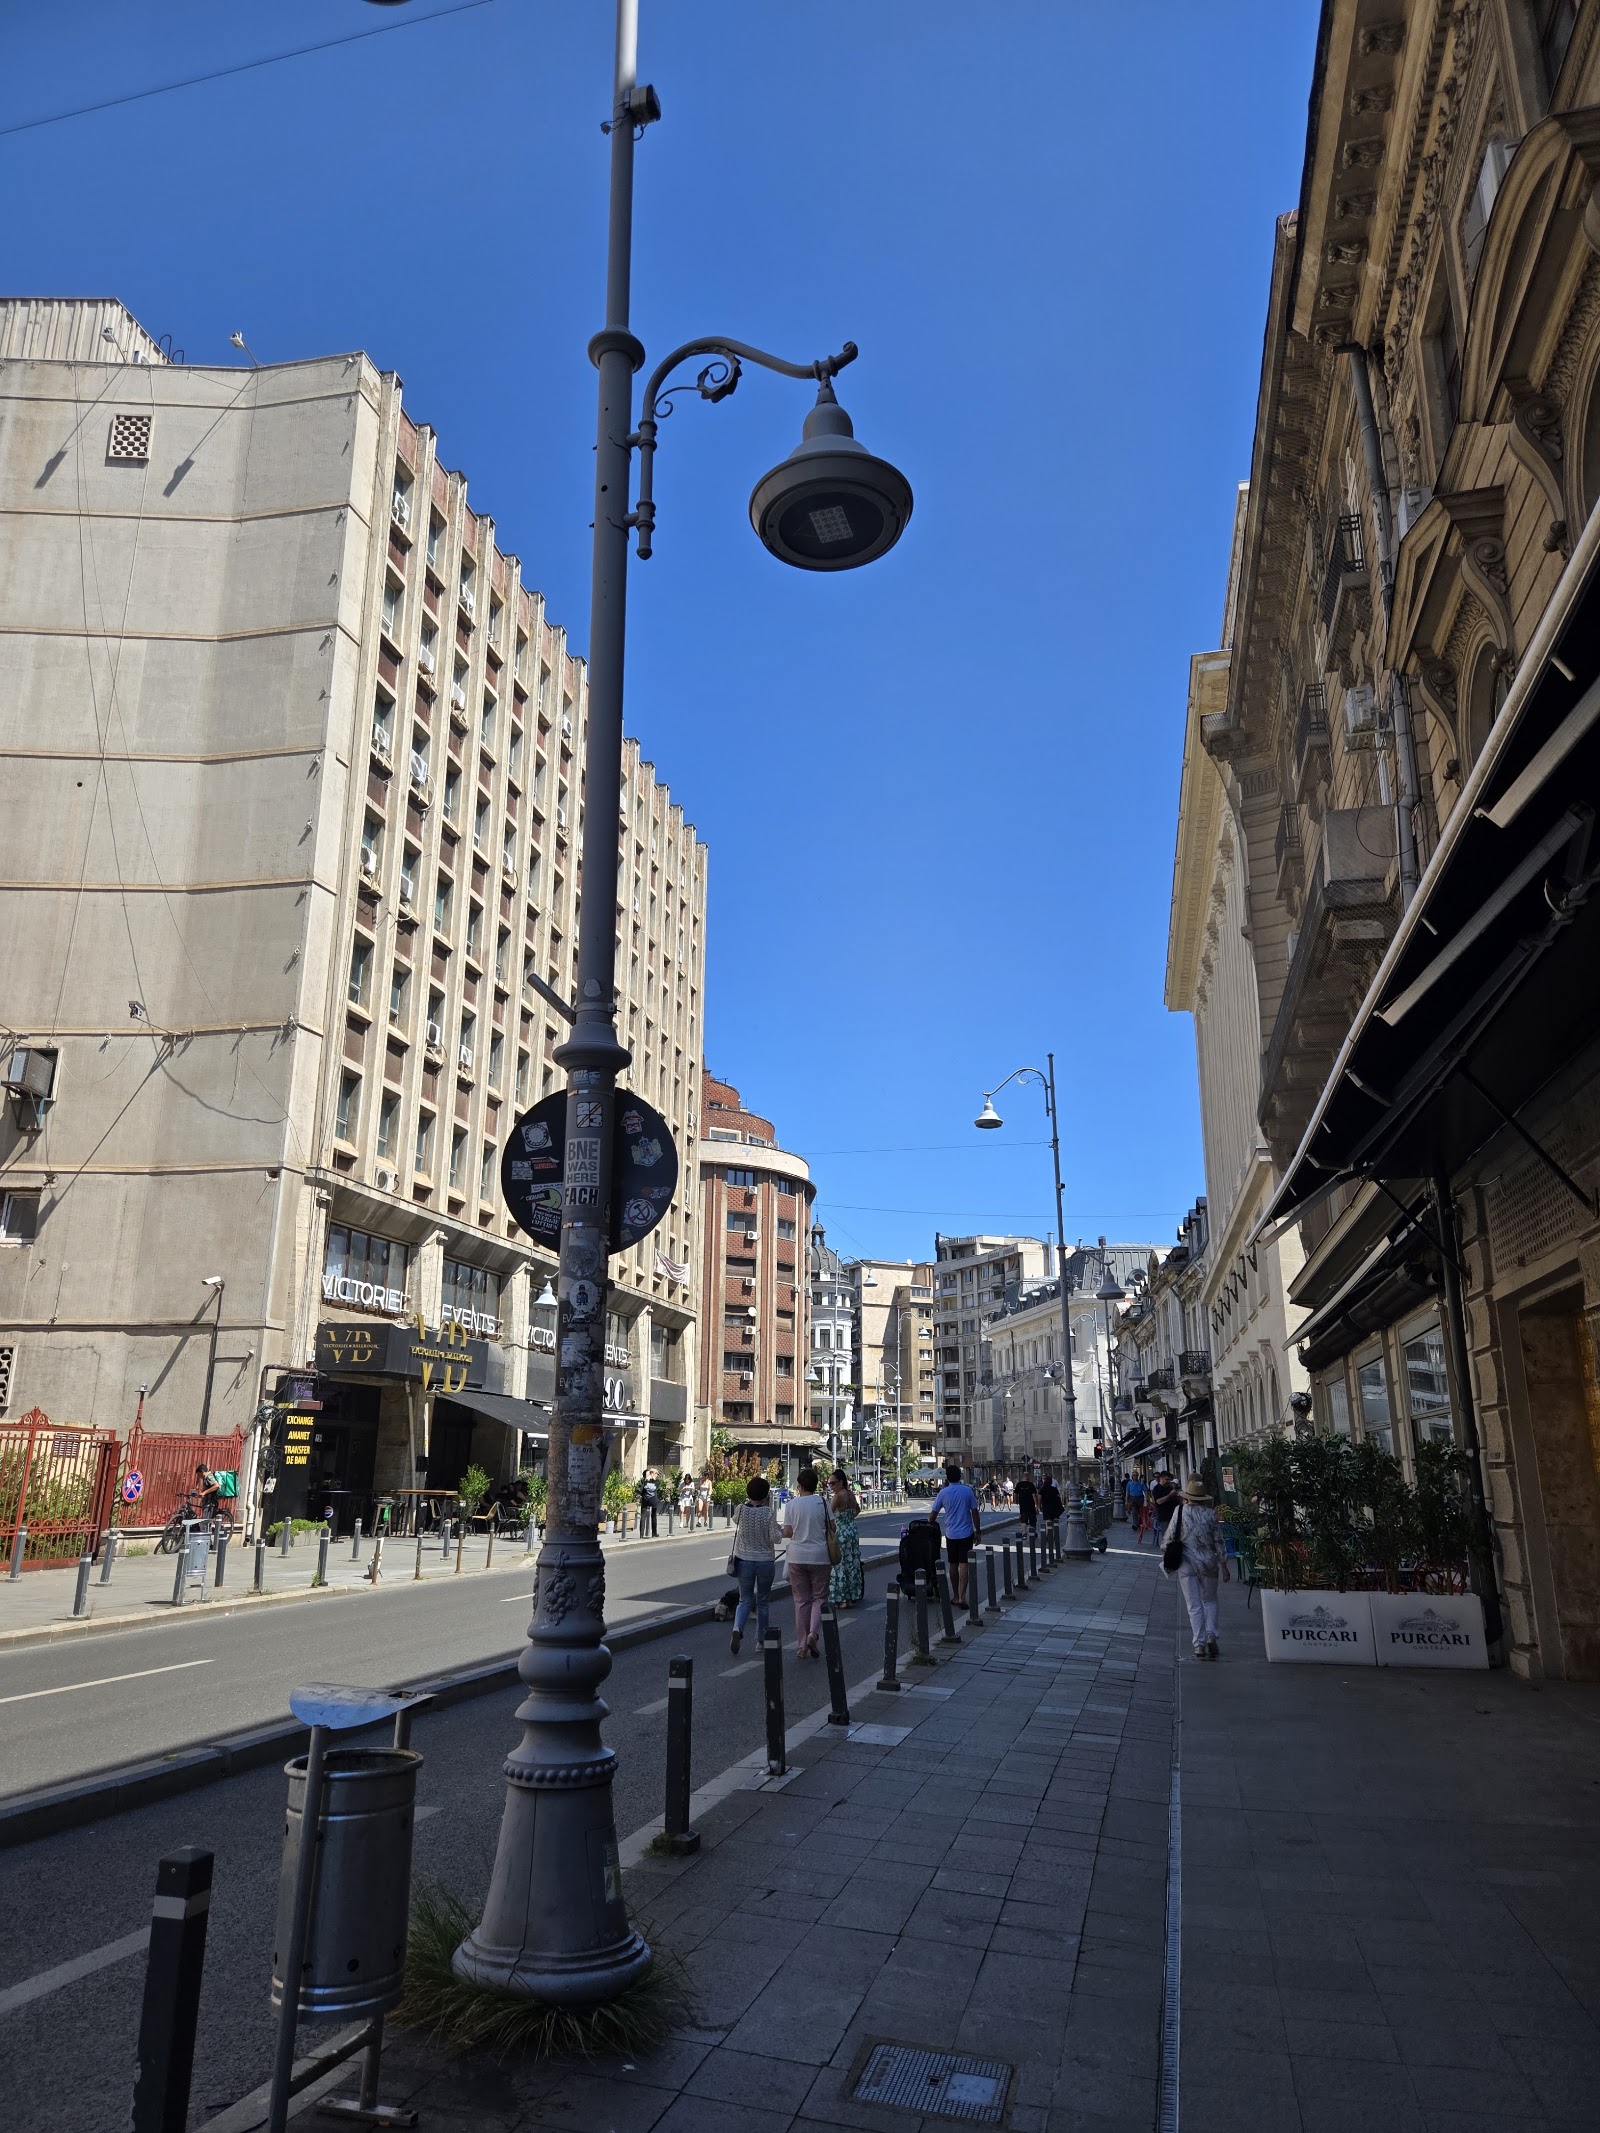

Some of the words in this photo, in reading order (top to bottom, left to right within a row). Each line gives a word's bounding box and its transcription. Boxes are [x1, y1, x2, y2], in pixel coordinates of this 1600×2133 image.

[568, 1140, 598, 1161] BNE
[568, 1161, 597, 1172] WAS
[567, 1172, 597, 1184] HERE
[564, 1187, 598, 1206] FACH
[322, 1274, 404, 1313] VICTORIEI
[442, 1303, 496, 1338] EVENTS
[287, 1416, 314, 1425] EXCHANGE
[288, 1431, 310, 1440] AMANET
[284, 1446, 310, 1455] TRANSFER
[286, 1456, 294, 1464] DE
[294, 1456, 307, 1464] BANI
[1281, 1629, 1358, 1642] PURCARI
[1391, 1633, 1470, 1645] PURCARI
